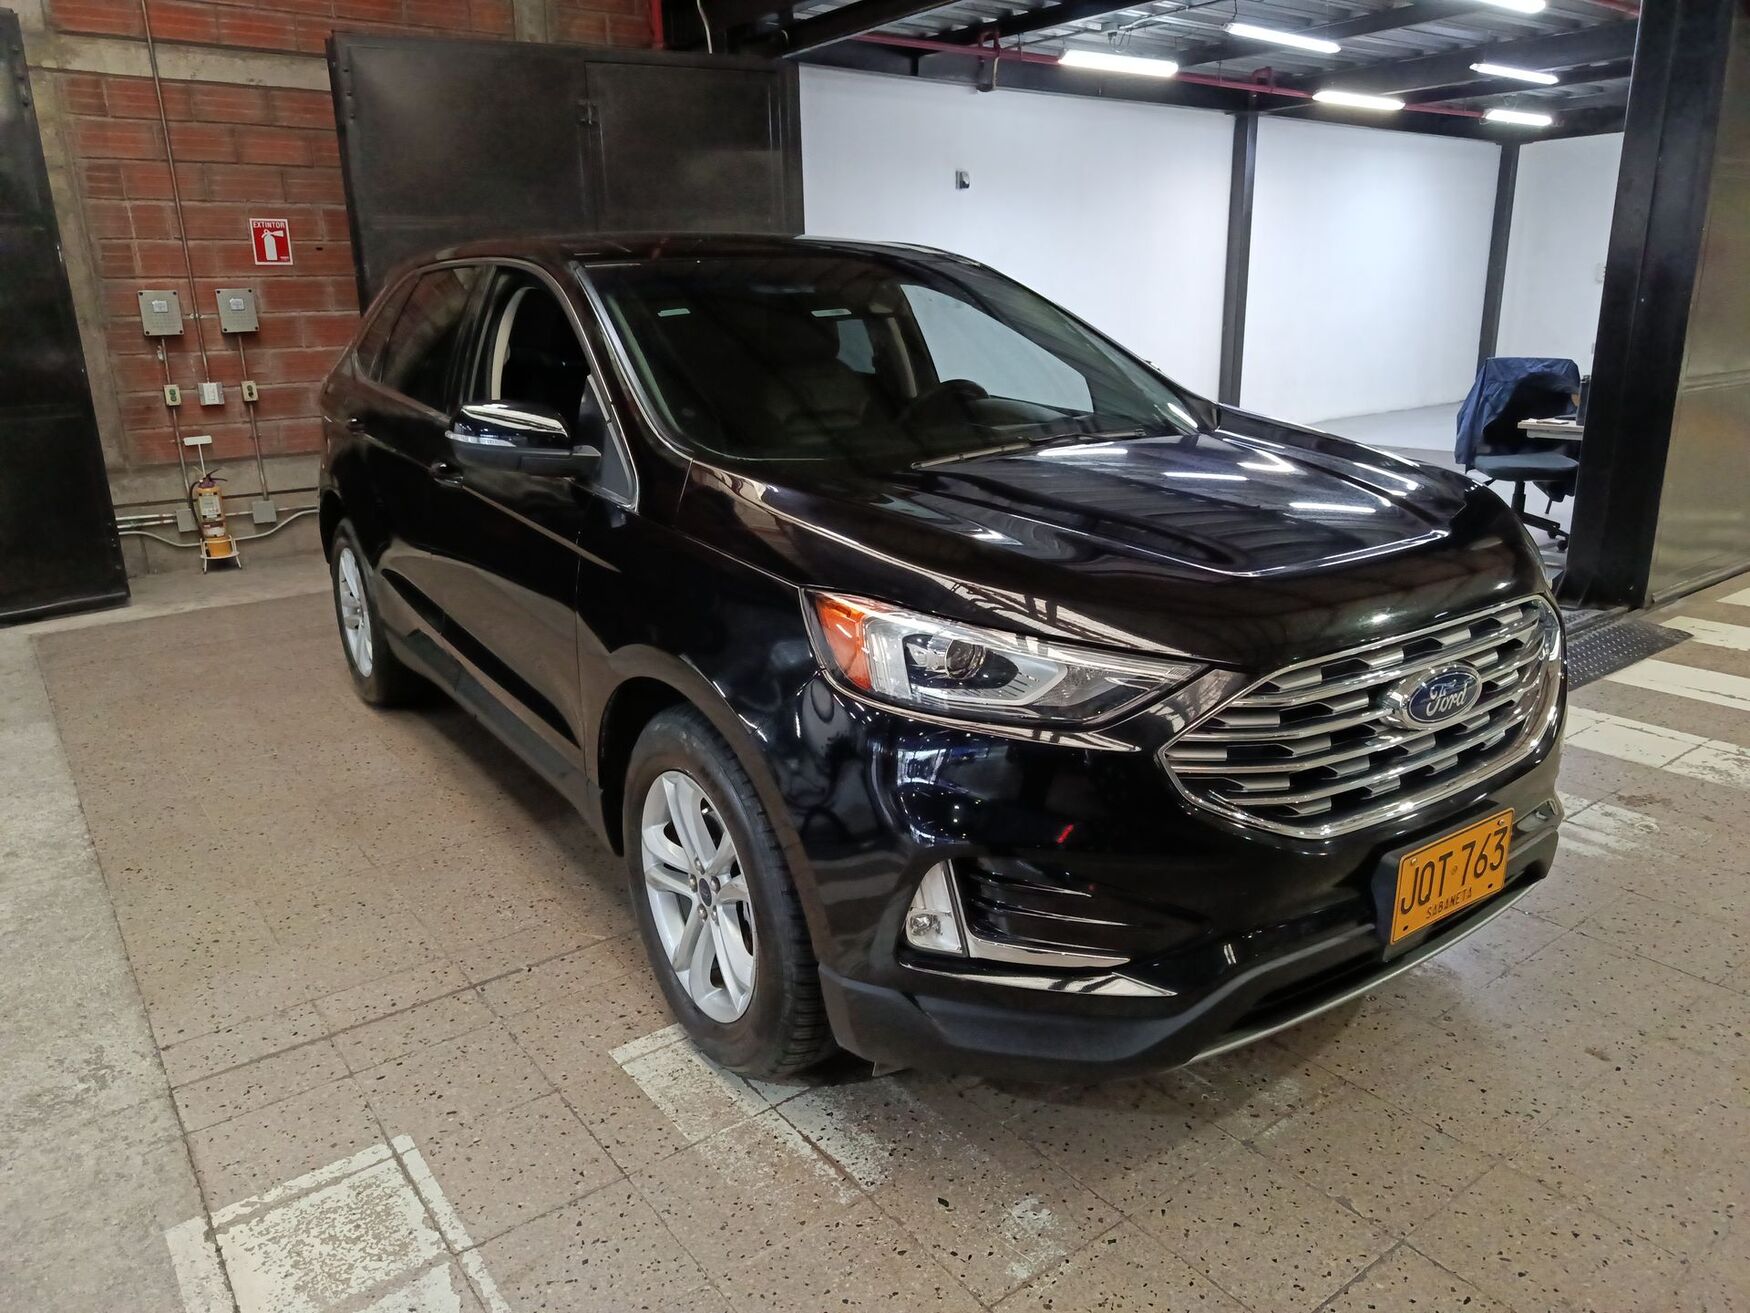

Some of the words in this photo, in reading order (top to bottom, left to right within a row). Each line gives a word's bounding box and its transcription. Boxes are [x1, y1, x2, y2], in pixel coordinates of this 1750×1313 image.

[253, 221, 286, 229] EXTINTOR
[1426, 679, 1468, 717] Ford
[1461, 826, 1508, 886] 763
[1426, 888, 1472, 919] SABANETA
